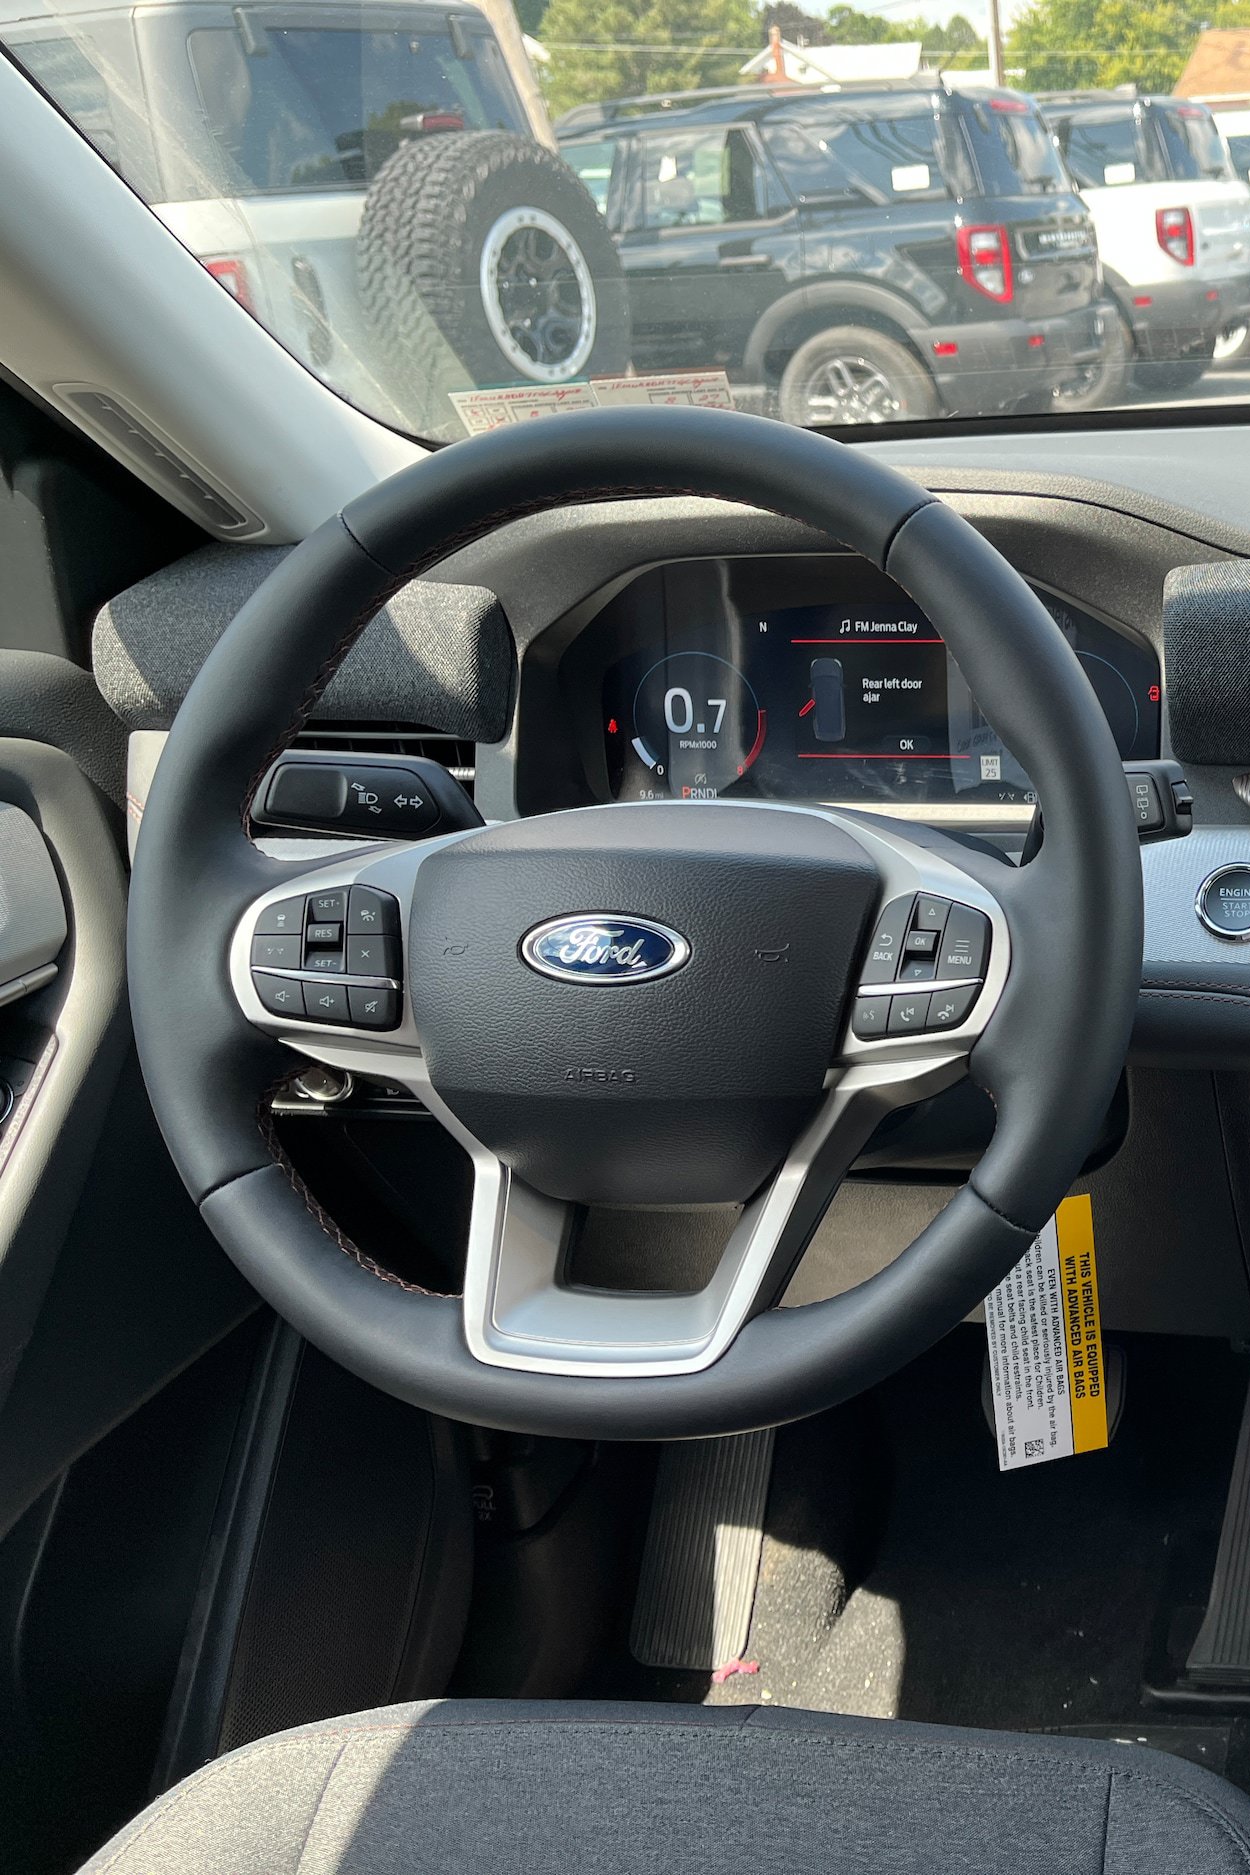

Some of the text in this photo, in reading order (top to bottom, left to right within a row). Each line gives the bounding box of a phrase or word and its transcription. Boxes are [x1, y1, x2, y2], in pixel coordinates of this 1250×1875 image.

[759, 622, 767, 632] N
[855, 622, 917, 634] FM Jenna Clay
[862, 678, 922, 689] Rear left door
[863, 692, 880, 703] ajar
[664, 688, 726, 733] 0.7
[680, 740, 717, 749] RPMx1000
[900, 740, 914, 750] OK
[657, 765, 664, 775] 0
[981, 758, 999, 767] LIMIT
[985, 769, 997, 778] 25
[640, 790, 654, 799] 9.6
[559, 926, 647, 968] Ford
[873, 952, 893, 961] BACK
[948, 956, 972, 965] MENU
[564, 1069, 636, 1084] AIRBAG
[1006, 1284, 1014, 1300] seat
[1028, 1289, 1036, 1297] is
[1038, 1282, 1045, 1292] be
[1016, 1300, 1026, 1324] facing
[1029, 1298, 1037, 1311] the
[1040, 1294, 1048, 1315] killed
[1008, 1303, 1016, 1323] belts
[988, 1311, 997, 1340] REMOVED
[1030, 1314, 1038, 1337] safest
[1042, 1318, 1047, 1326] or
[1065, 1256, 1085, 1398] WITH ADVANCED AIR BAGS
[1079, 1252, 1100, 1397] THIS VEHICLE IS EQUIPPED
[1020, 1326, 1029, 1345] child
[1047, 1269, 1065, 1395] EVEN WITH ADVANCED AIR BAGS
[1011, 1341, 1020, 1361] child
[1031, 1340, 1040, 1360] place
[1042, 1329, 1052, 1364] seriously
[1022, 1348, 1030, 1365] seat
[992, 1350, 1000, 1382] CUSTOMER
[996, 1289, 1017, 1457] manual for more information about air bags.
[1034, 1362, 1042, 1373] for
[1014, 1362, 1022, 1401] restraints.
[1025, 1375, 1033, 1388] the
[1044, 1366, 1054, 1393] injured
[1026, 1390, 1034, 1410] front.
[1035, 1375, 1043, 1410] Children.
[1047, 1395, 1055, 1405] by
[1048, 1406, 1056, 1417] the
[1050, 1431, 1058, 1447] bag.
